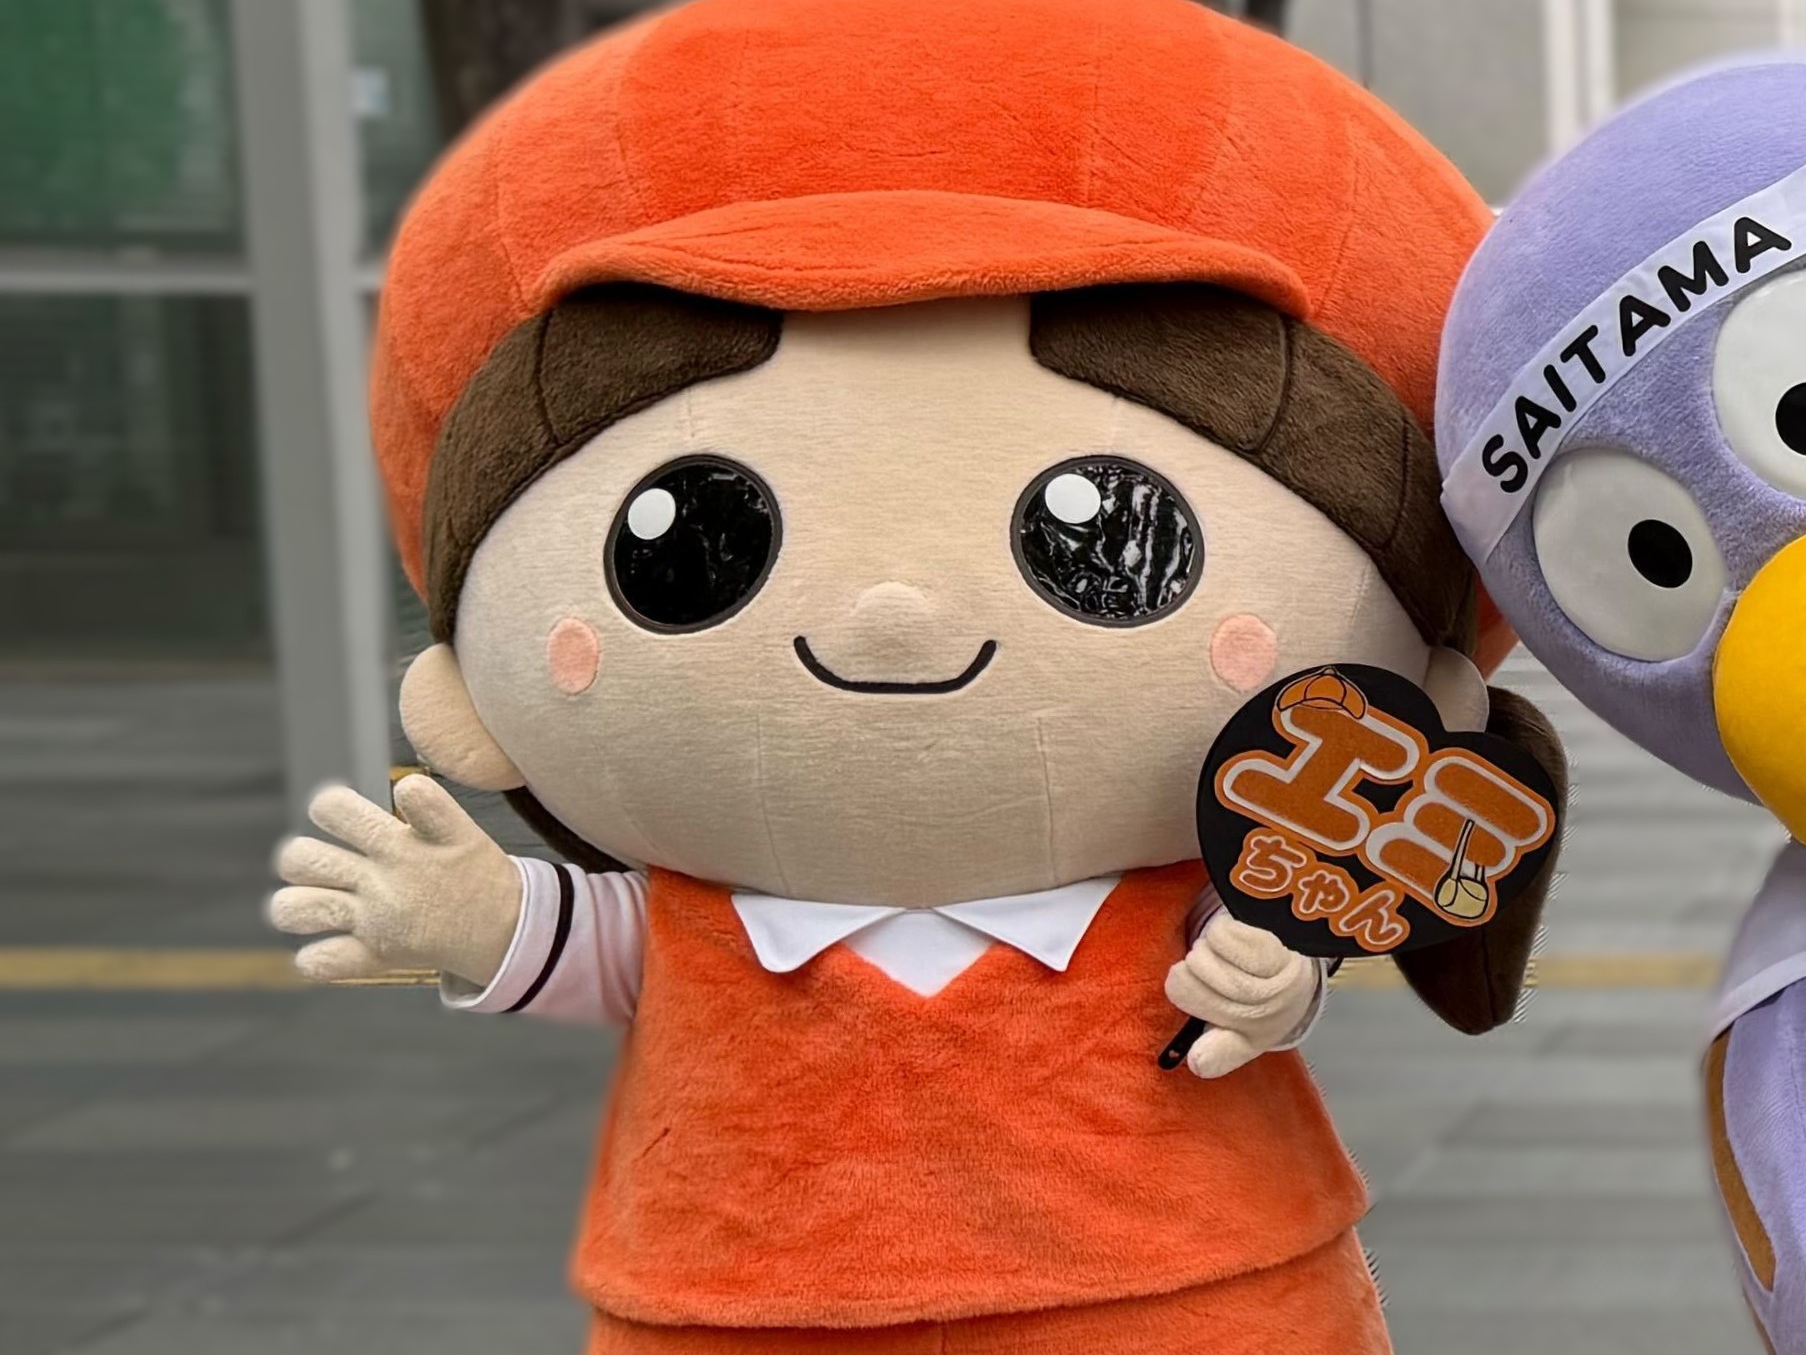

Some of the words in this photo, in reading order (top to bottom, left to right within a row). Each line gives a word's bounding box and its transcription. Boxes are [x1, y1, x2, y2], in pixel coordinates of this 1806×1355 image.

[1481, 216, 1792, 493] SAITAMA
[1218, 702, 1554, 921] エミ
[1235, 831, 1406, 948] ちゃん
